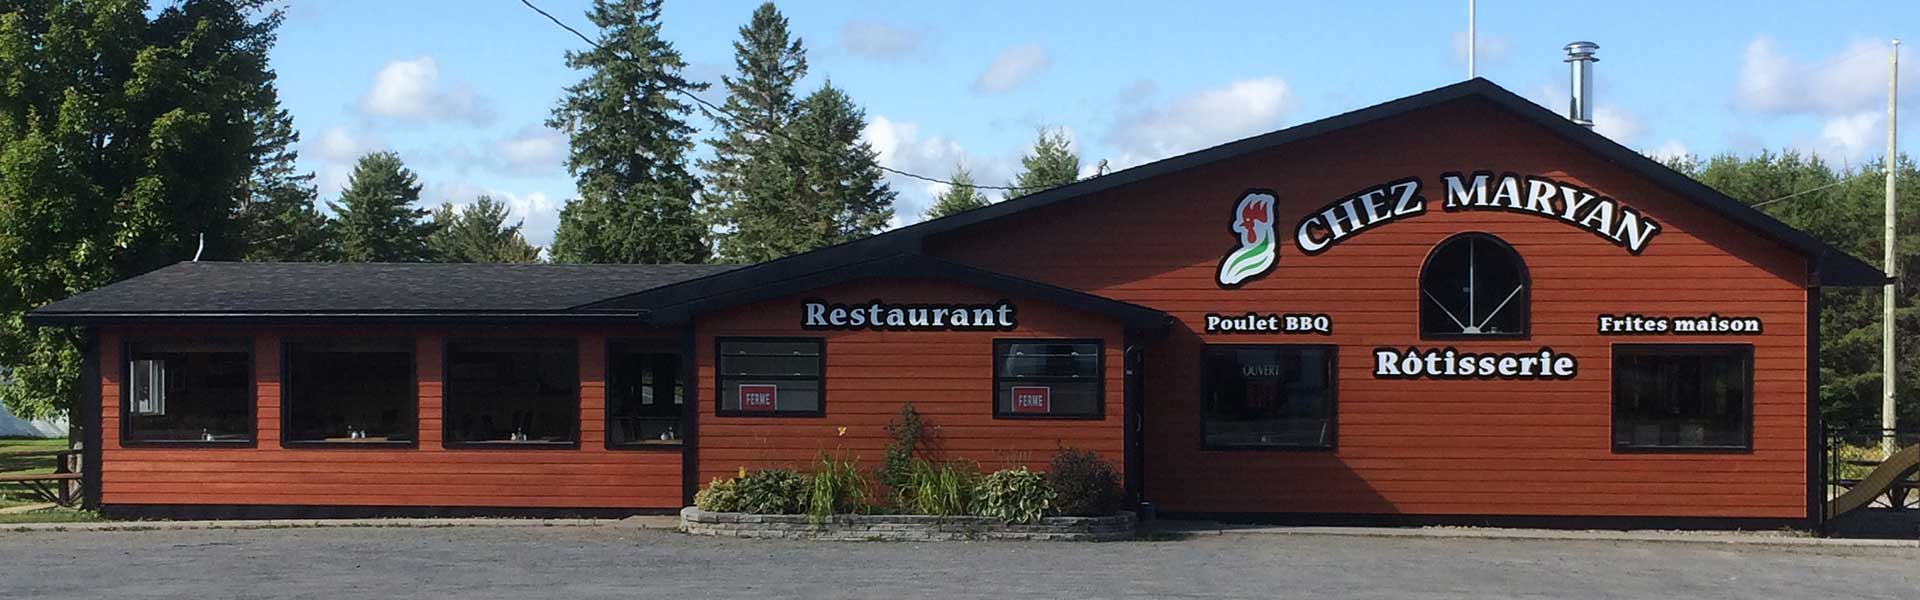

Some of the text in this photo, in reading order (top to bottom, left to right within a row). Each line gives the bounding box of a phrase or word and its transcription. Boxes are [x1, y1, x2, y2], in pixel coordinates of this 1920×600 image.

[1297, 175, 1656, 251] CHEZ MARYAN
[805, 303, 1013, 326] Restaurant
[1207, 315, 1329, 332] Poulet BBQ
[1600, 316, 1759, 331] Frites maison
[1242, 364, 1280, 376] OUVERT
[1376, 351, 1573, 375] Rôtisserie
